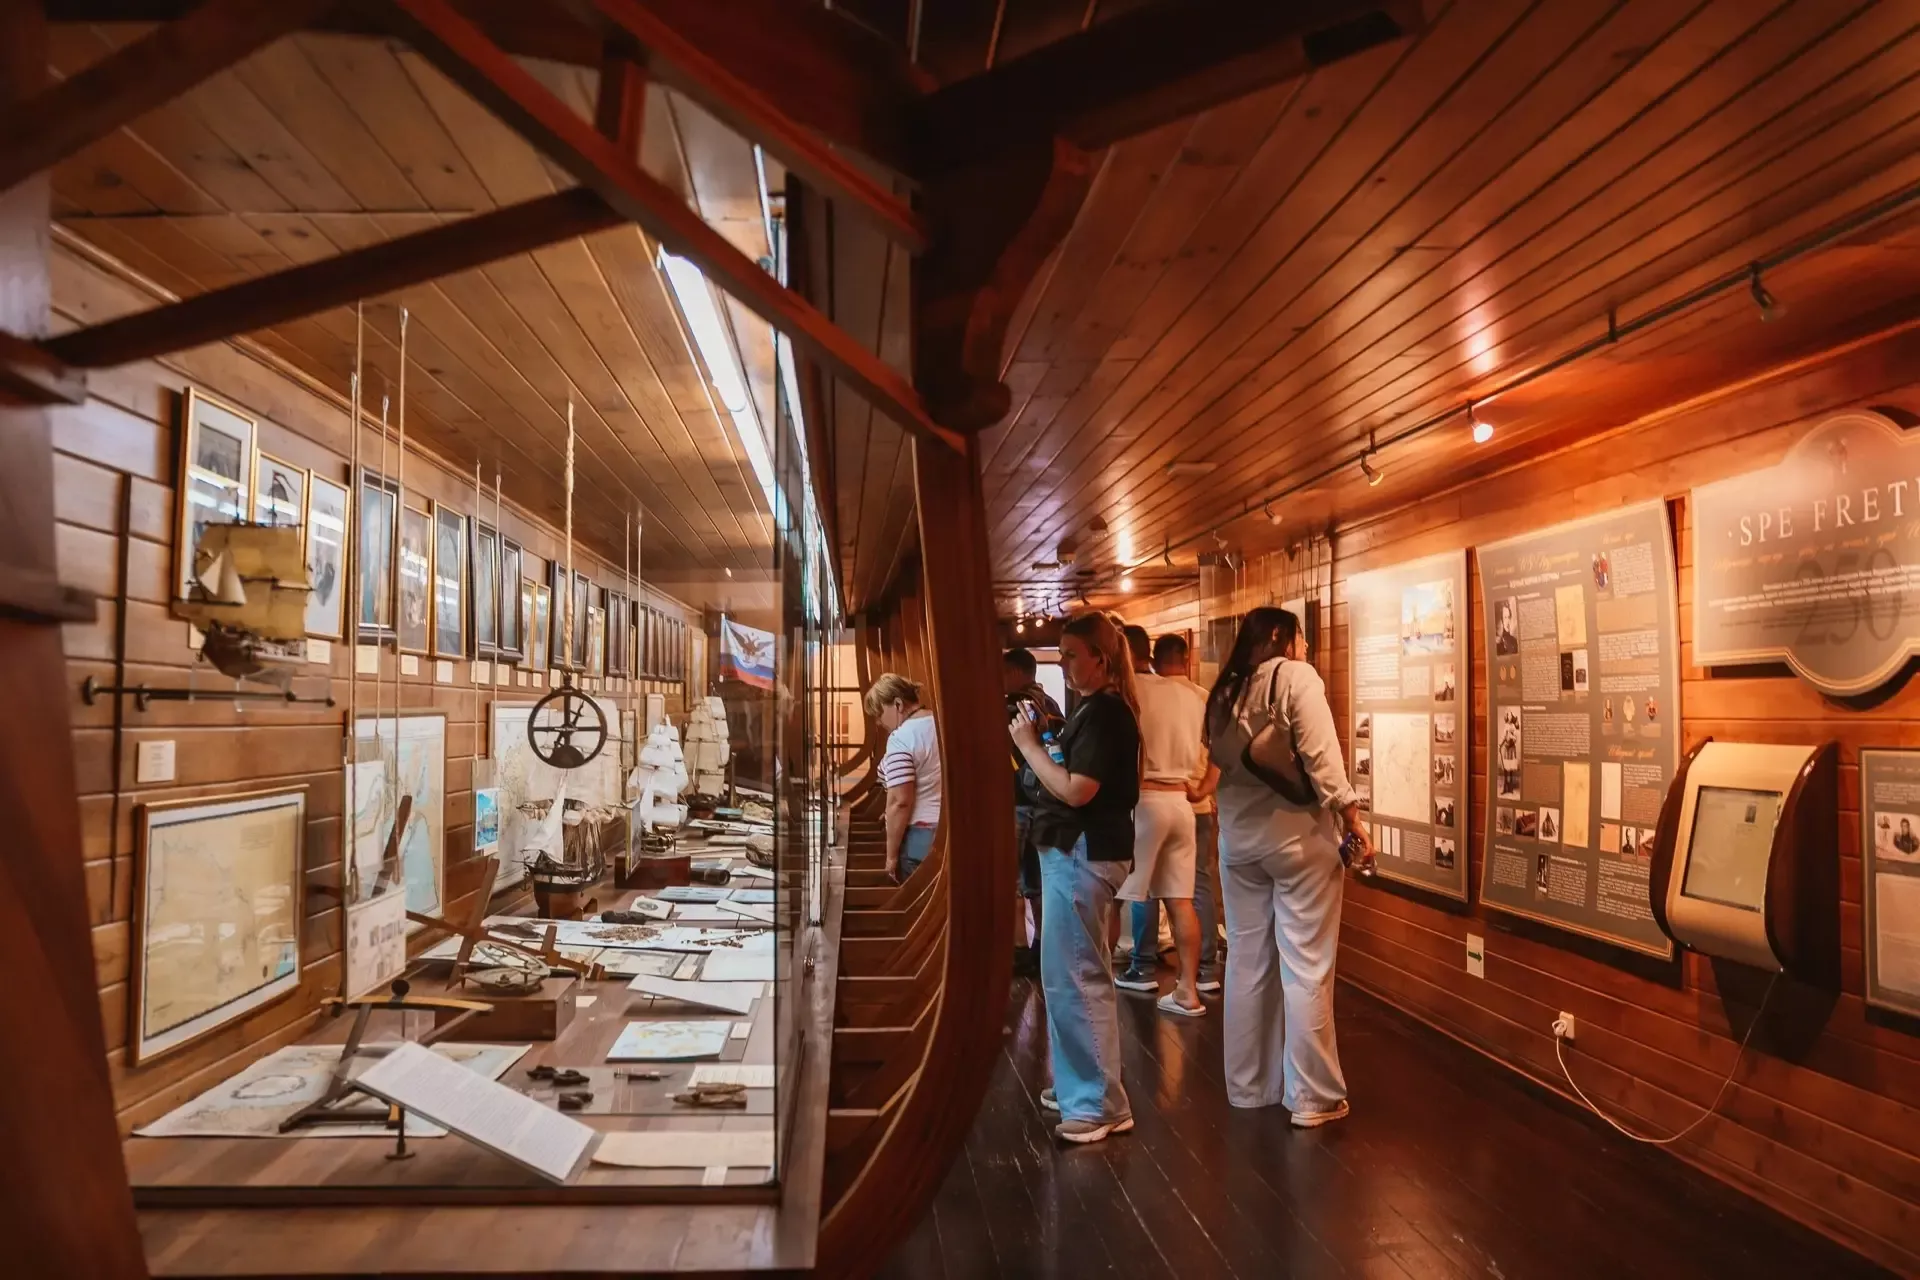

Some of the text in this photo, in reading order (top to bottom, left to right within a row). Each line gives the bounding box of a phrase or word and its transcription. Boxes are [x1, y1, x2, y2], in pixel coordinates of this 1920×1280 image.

[1741, 477, 1920, 546] SPE FRET
[1795, 548, 1901, 645] 250
